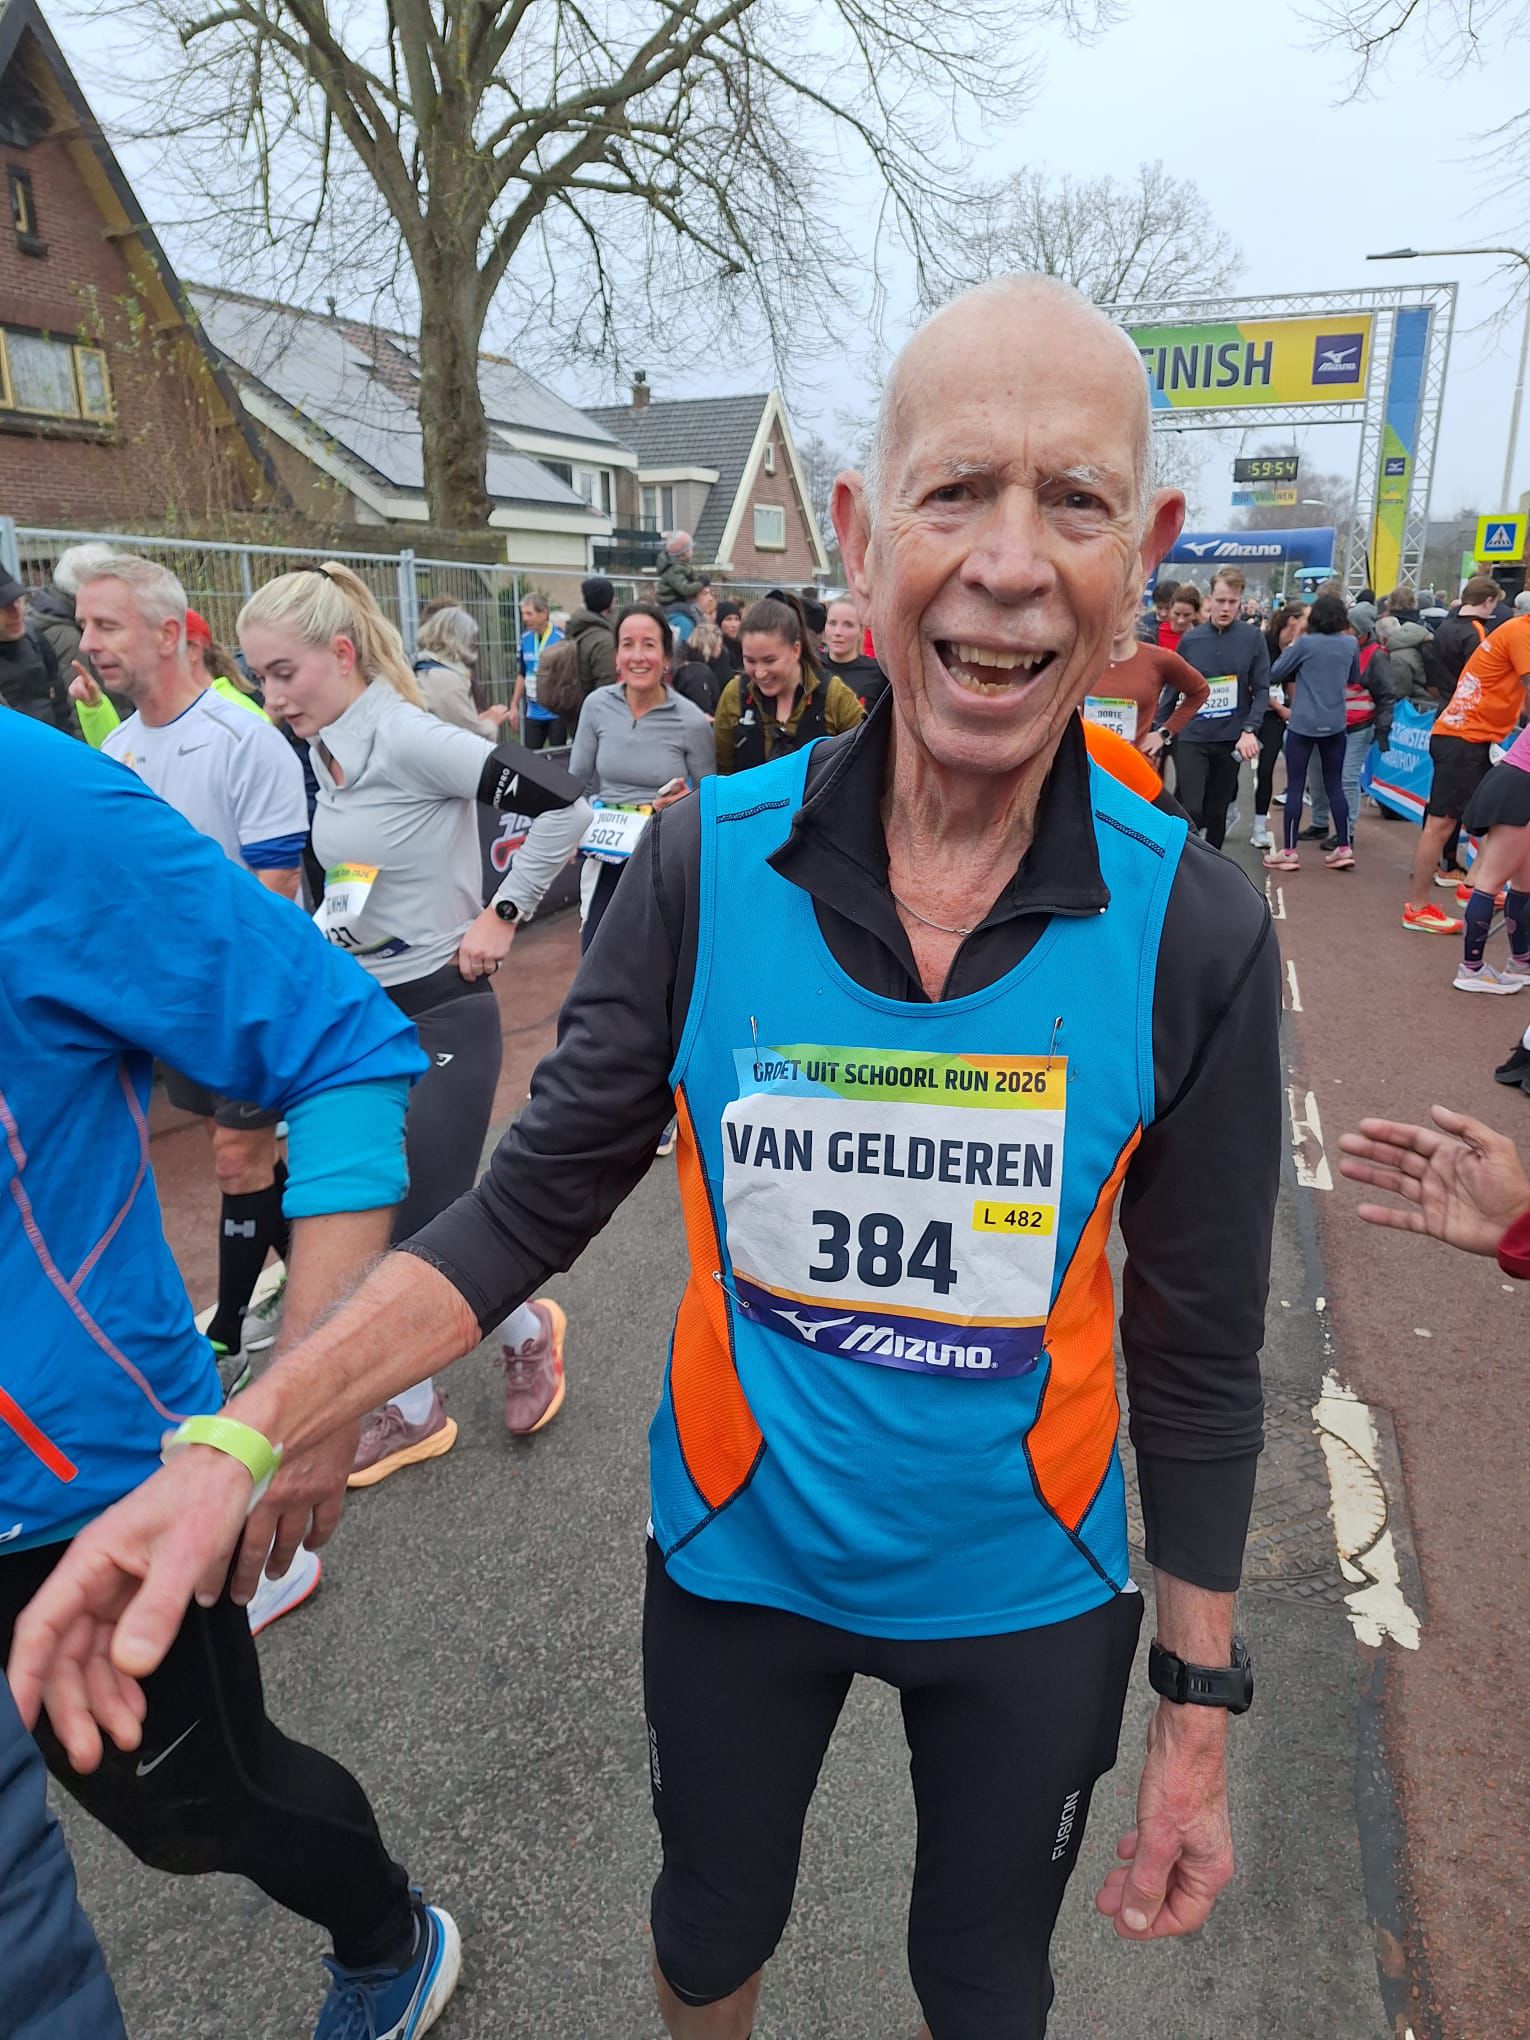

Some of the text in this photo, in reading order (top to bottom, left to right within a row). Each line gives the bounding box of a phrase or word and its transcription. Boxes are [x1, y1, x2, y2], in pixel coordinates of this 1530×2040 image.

[597, 813, 628, 825] JUDITH
[588, 829, 624, 847] 5027
[753, 1059, 1047, 1093] GROET UIT SCHOORL RUN 2026
[726, 1122, 1053, 1187] VAN GELDEREN
[984, 1208, 1043, 1228] L 482
[808, 1209, 958, 1295] 384
[1051, 1789, 1080, 1861] FUSION
